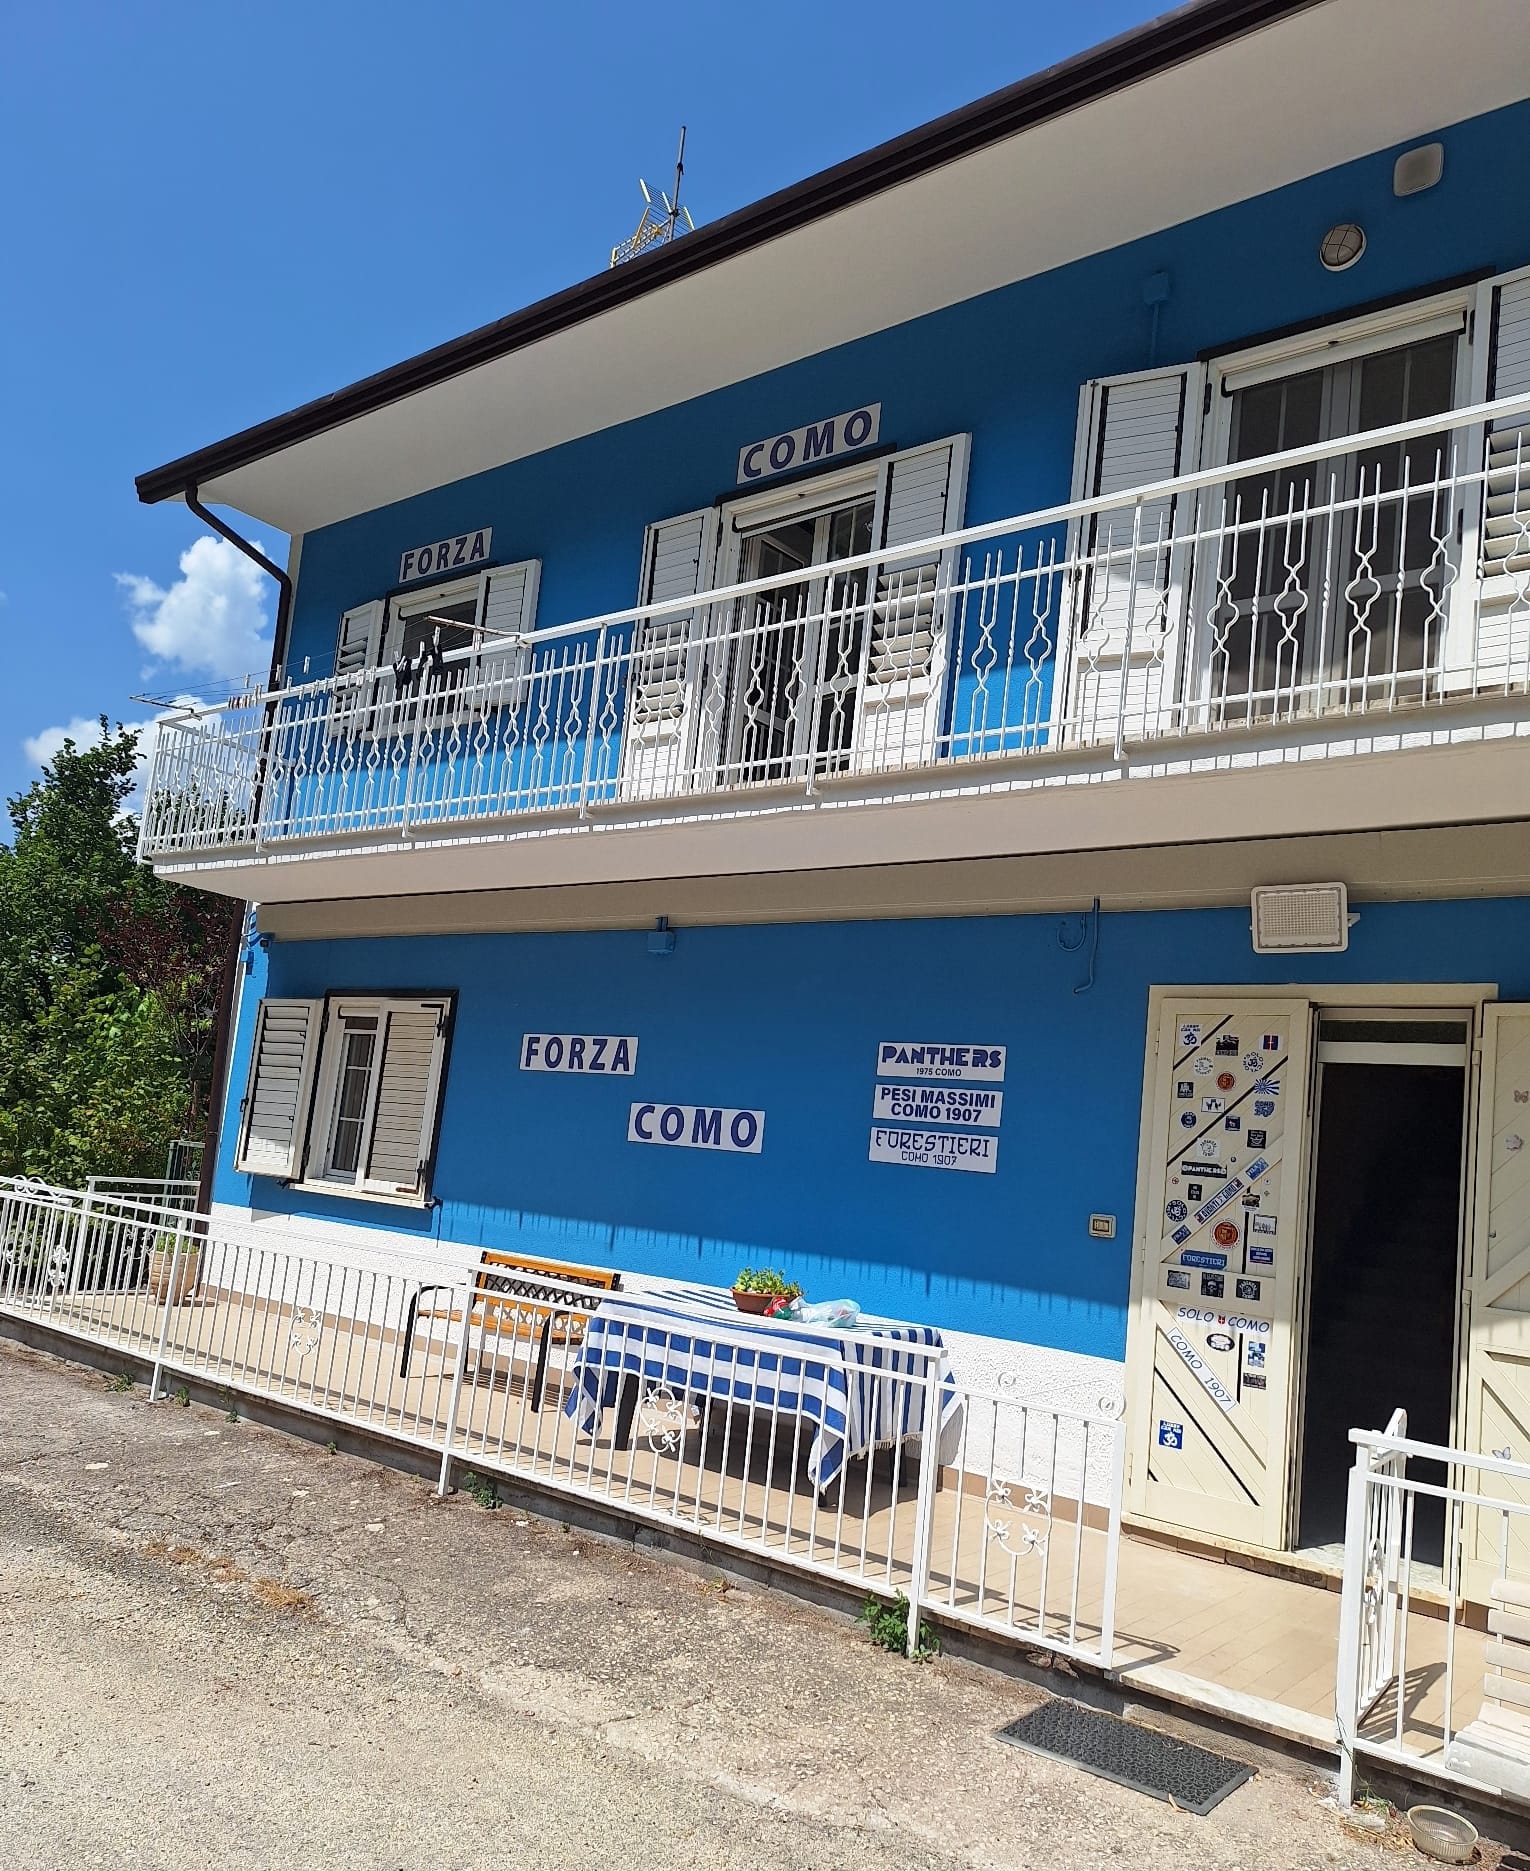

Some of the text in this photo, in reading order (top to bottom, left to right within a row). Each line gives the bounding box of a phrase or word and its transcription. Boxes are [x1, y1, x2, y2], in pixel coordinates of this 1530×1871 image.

[743, 410, 872, 478] COMO
[402, 531, 486, 582] FORZA
[525, 1036, 630, 1072] FORZA
[881, 1045, 1002, 1068] PANTHERS
[916, 1067, 962, 1077] 1975 COMO
[881, 1087, 996, 1109] PESI MASSIMI
[891, 1102, 982, 1123] COMO 1907
[634, 1105, 758, 1148] COMO
[901, 1150, 958, 1167] COMO 1907
[1182, 1253, 1225, 1267] FORESTIERI
[1177, 1307, 1270, 1333] SOLO COMO
[1170, 1335, 1232, 1403] COMO 1907
